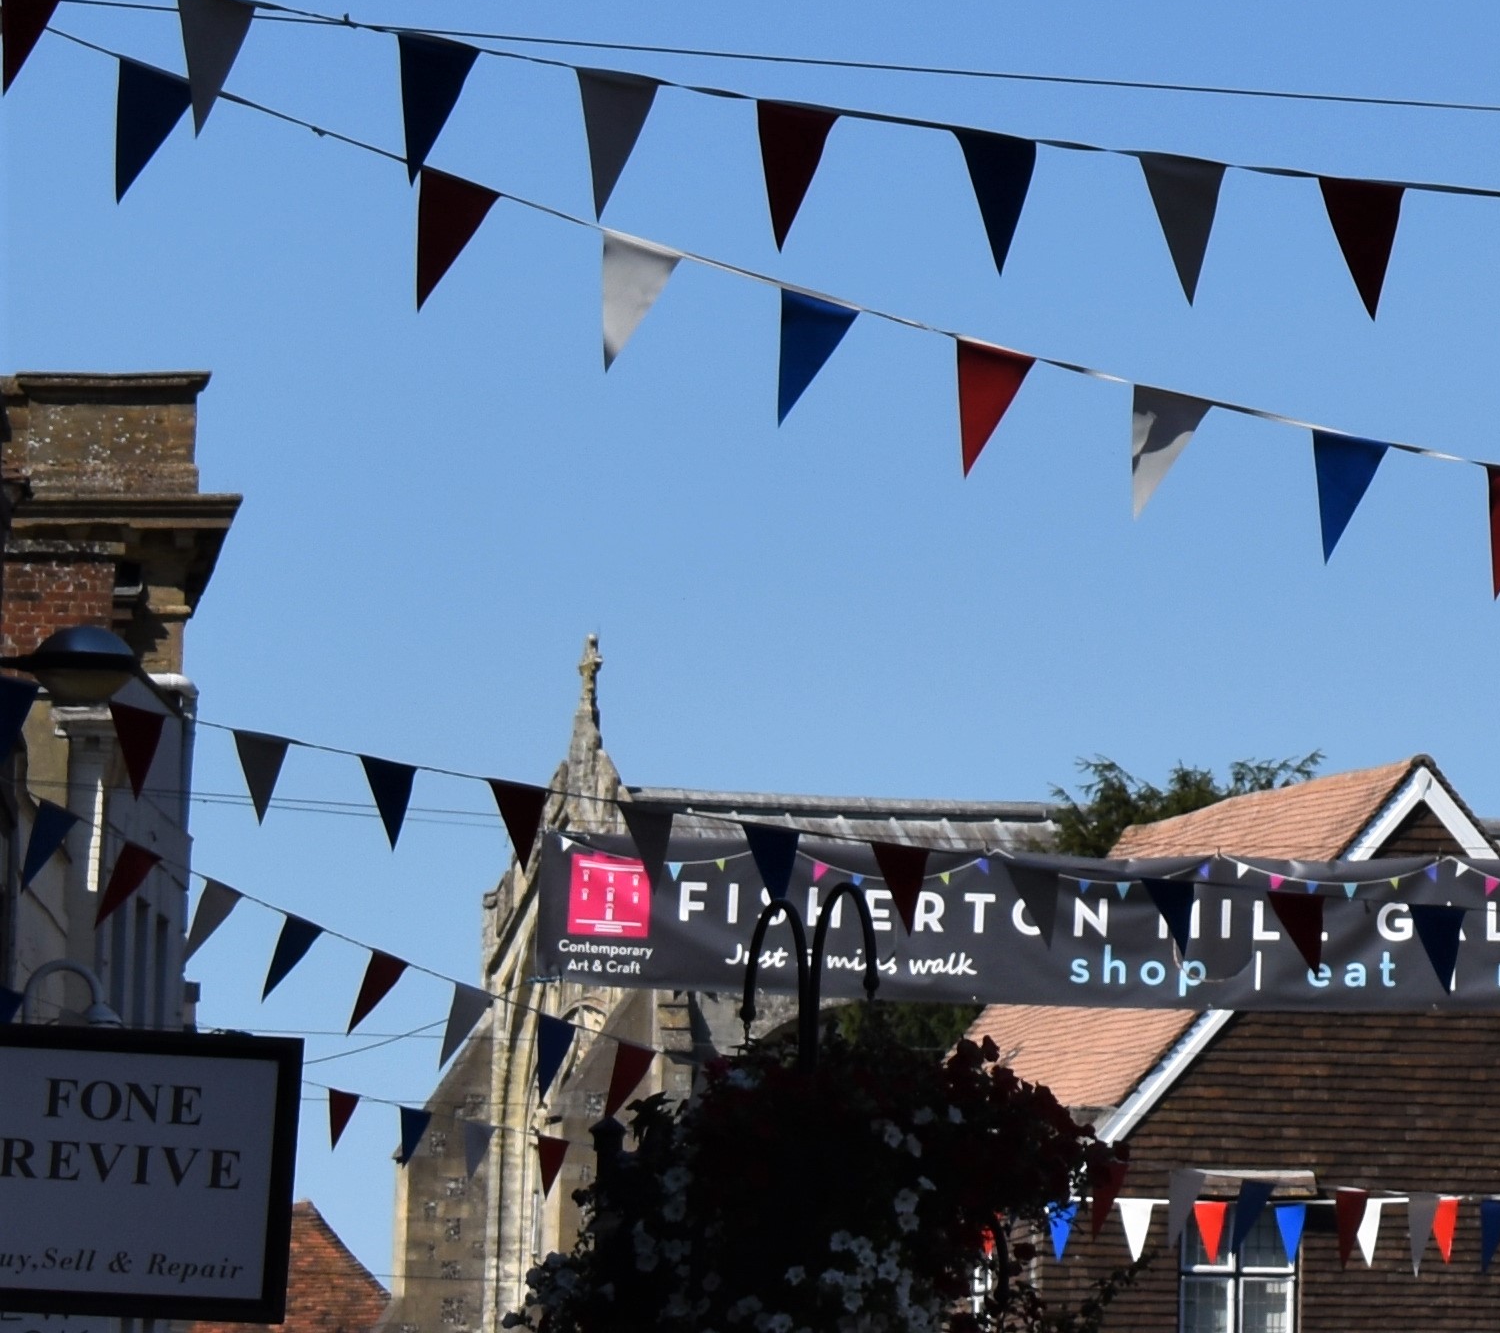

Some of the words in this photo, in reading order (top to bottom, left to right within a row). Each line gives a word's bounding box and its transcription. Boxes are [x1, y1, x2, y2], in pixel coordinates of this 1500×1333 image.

[1158, 898, 1329, 942] IL
[558, 938, 654, 960] Contemporary
[567, 958, 589, 972] Art
[592, 959, 603, 973] &
[606, 960, 641, 975] Craft
[908, 952, 978, 976] walk
[1069, 944, 1208, 997] shop
[1307, 951, 1397, 988] eat
[42, 1077, 203, 1128] FONE
[0, 1136, 242, 1190] REVIVE
[108, 1251, 133, 1275] &
[146, 1252, 244, 1283] Repair
